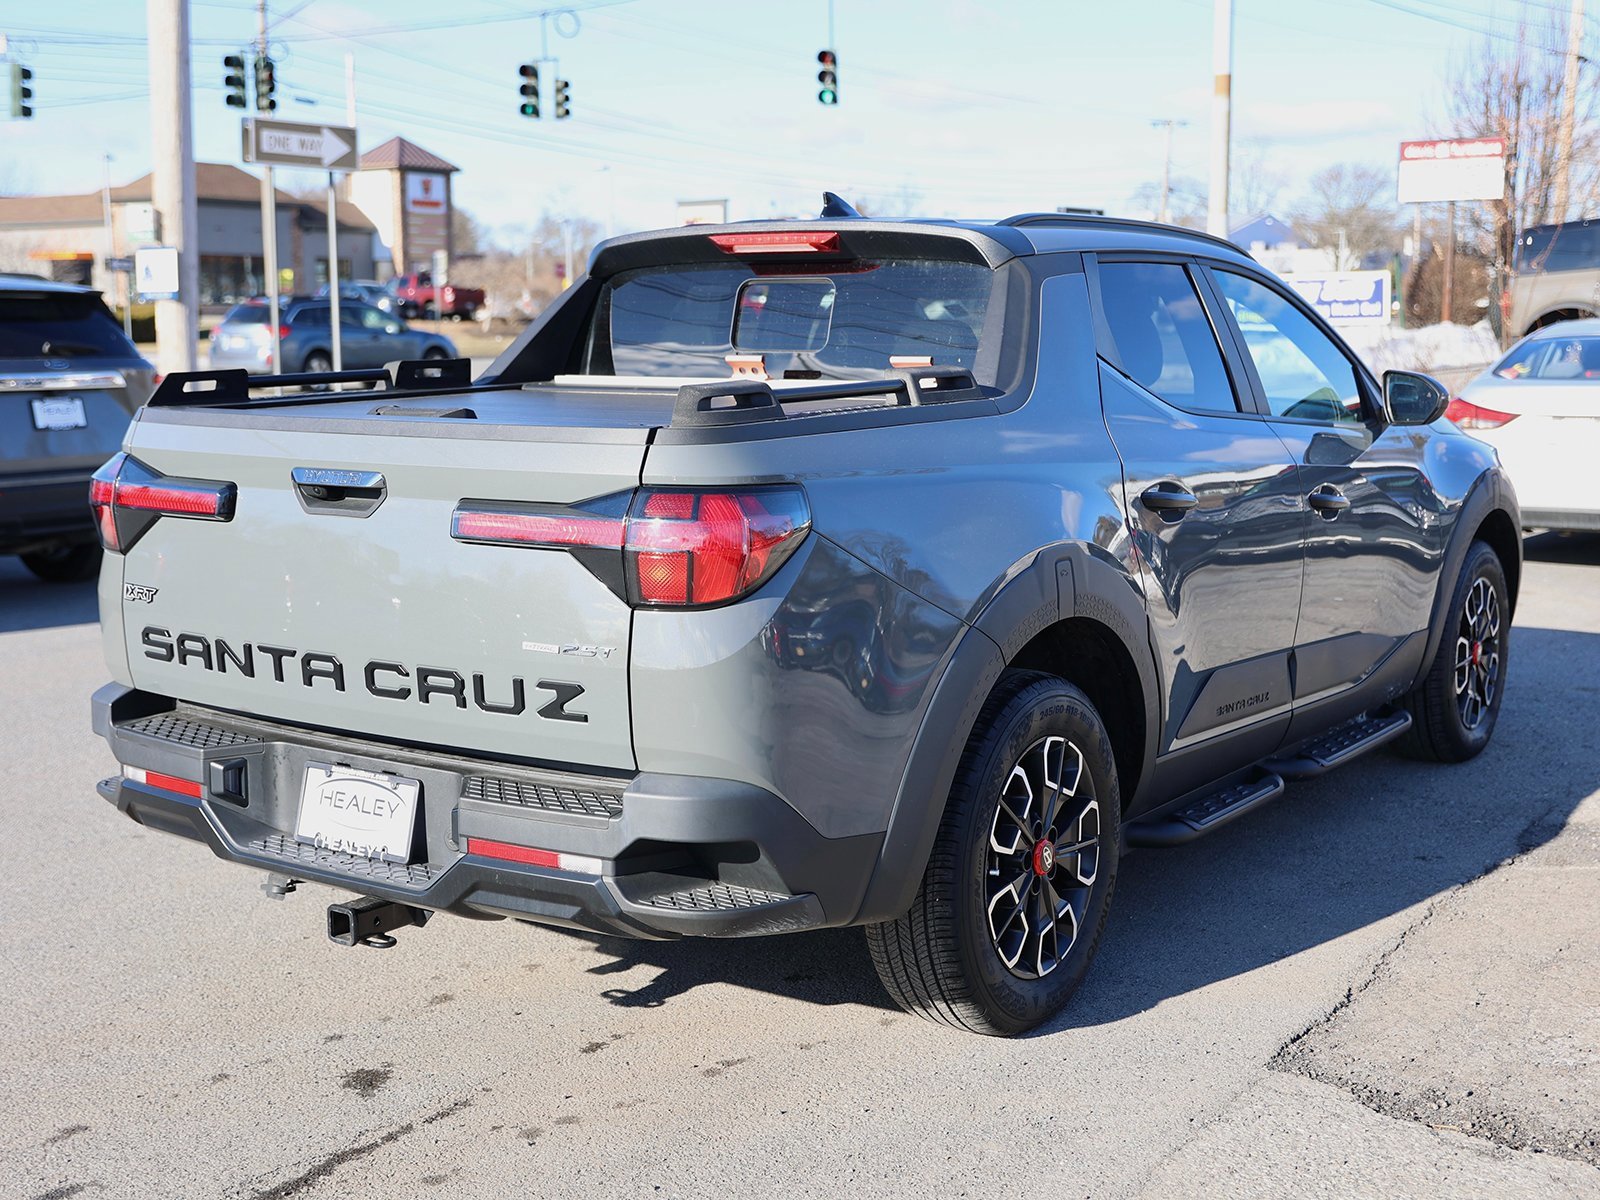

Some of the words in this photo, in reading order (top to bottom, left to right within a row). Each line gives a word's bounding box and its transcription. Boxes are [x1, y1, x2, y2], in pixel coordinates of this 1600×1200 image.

[268, 134, 293, 152] ONE
[298, 136, 324, 153] WAY
[124, 582, 160, 604] XRT
[141, 625, 346, 692] SANTA
[363, 660, 589, 723] CRUZ
[1216, 699, 1246, 717] SANTA
[319, 788, 400, 819] HEALEY
